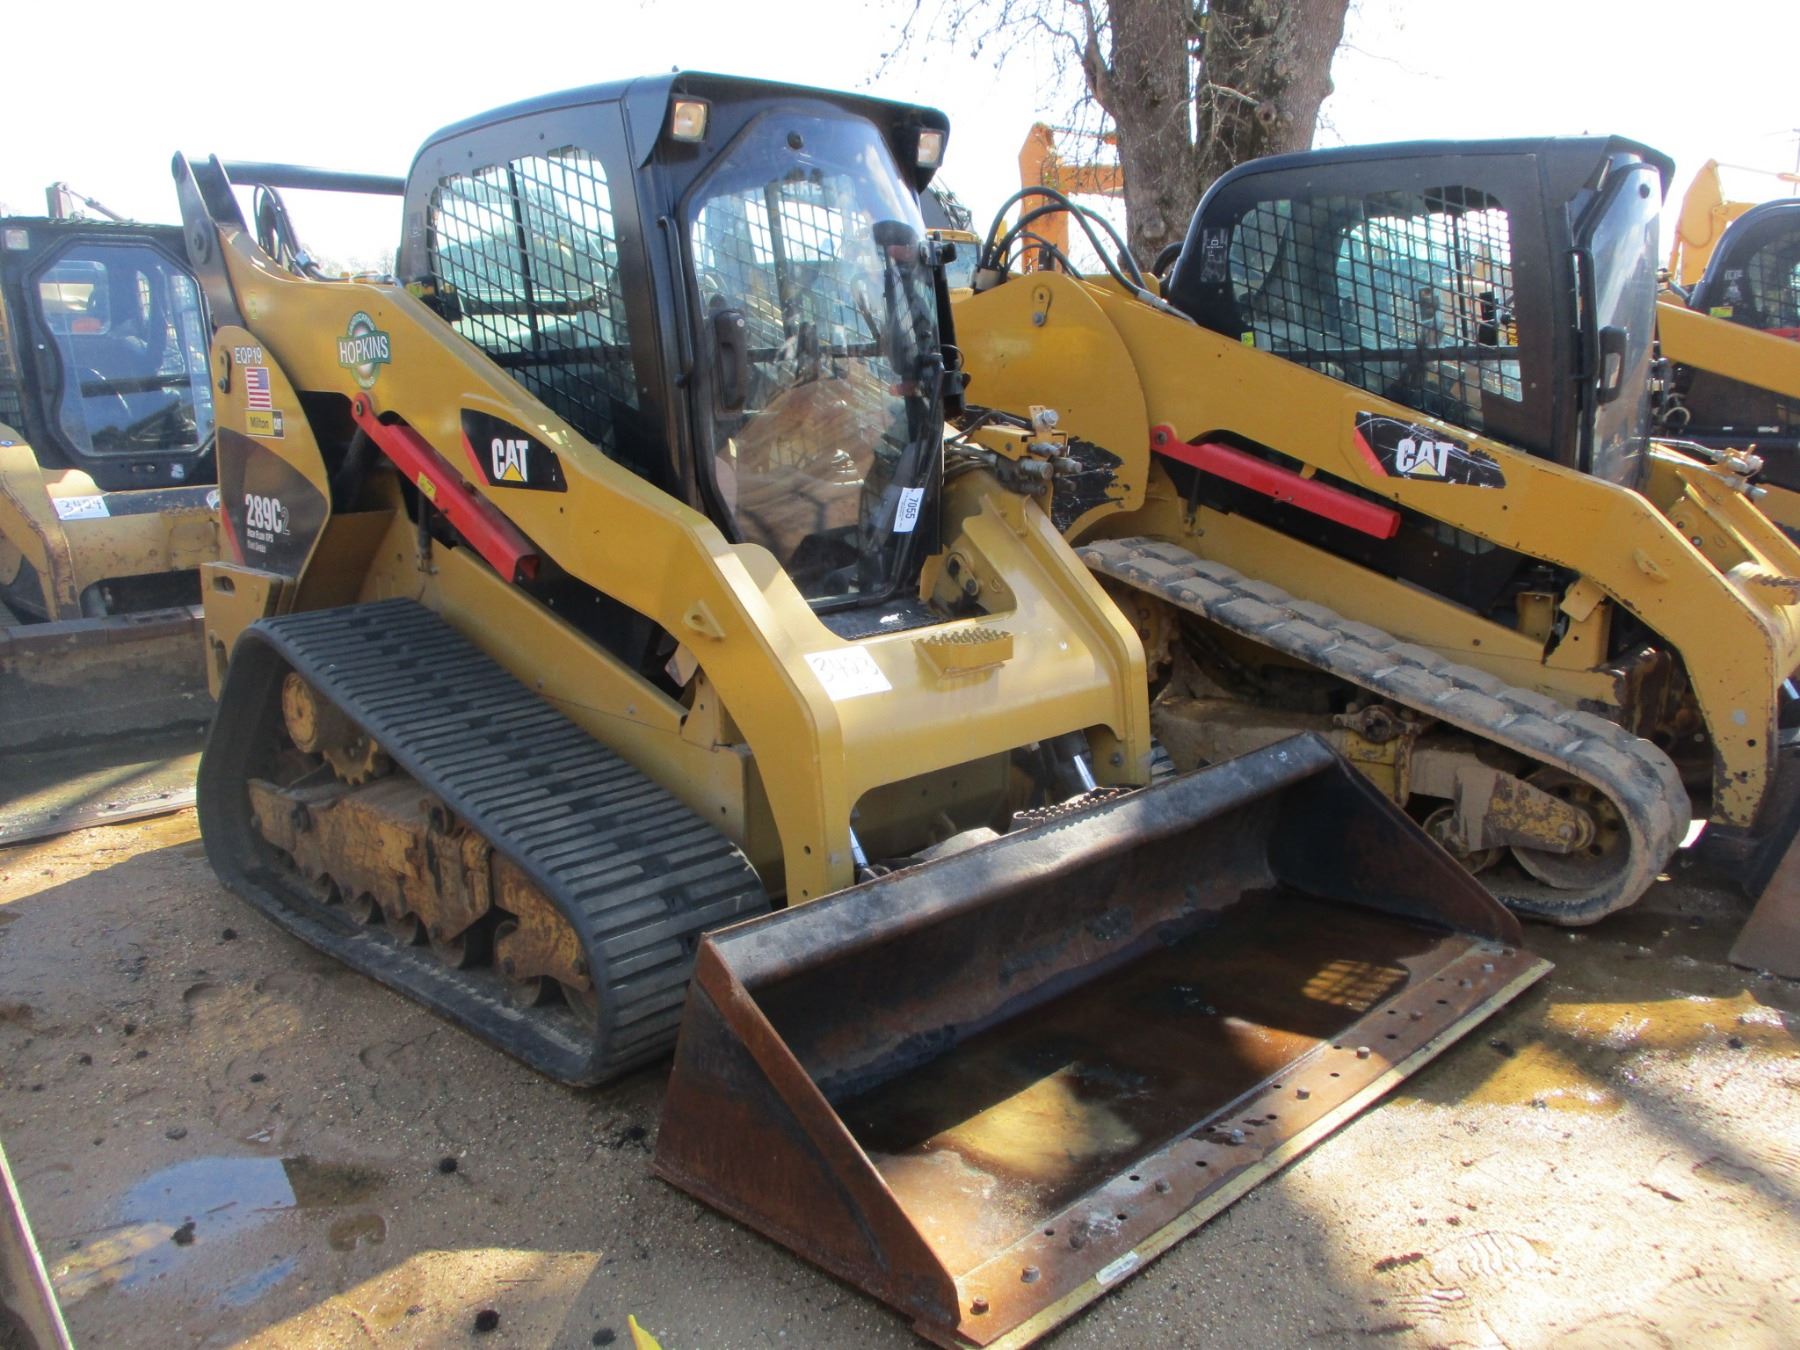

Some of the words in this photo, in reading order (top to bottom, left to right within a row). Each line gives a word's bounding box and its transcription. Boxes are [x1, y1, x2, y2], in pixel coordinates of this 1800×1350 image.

[234, 346, 262, 364] EQP19
[339, 335, 389, 364] HOPKINS
[491, 437, 529, 482] CAT
[1395, 438, 1455, 477] CAT
[904, 497, 919, 519] 7055
